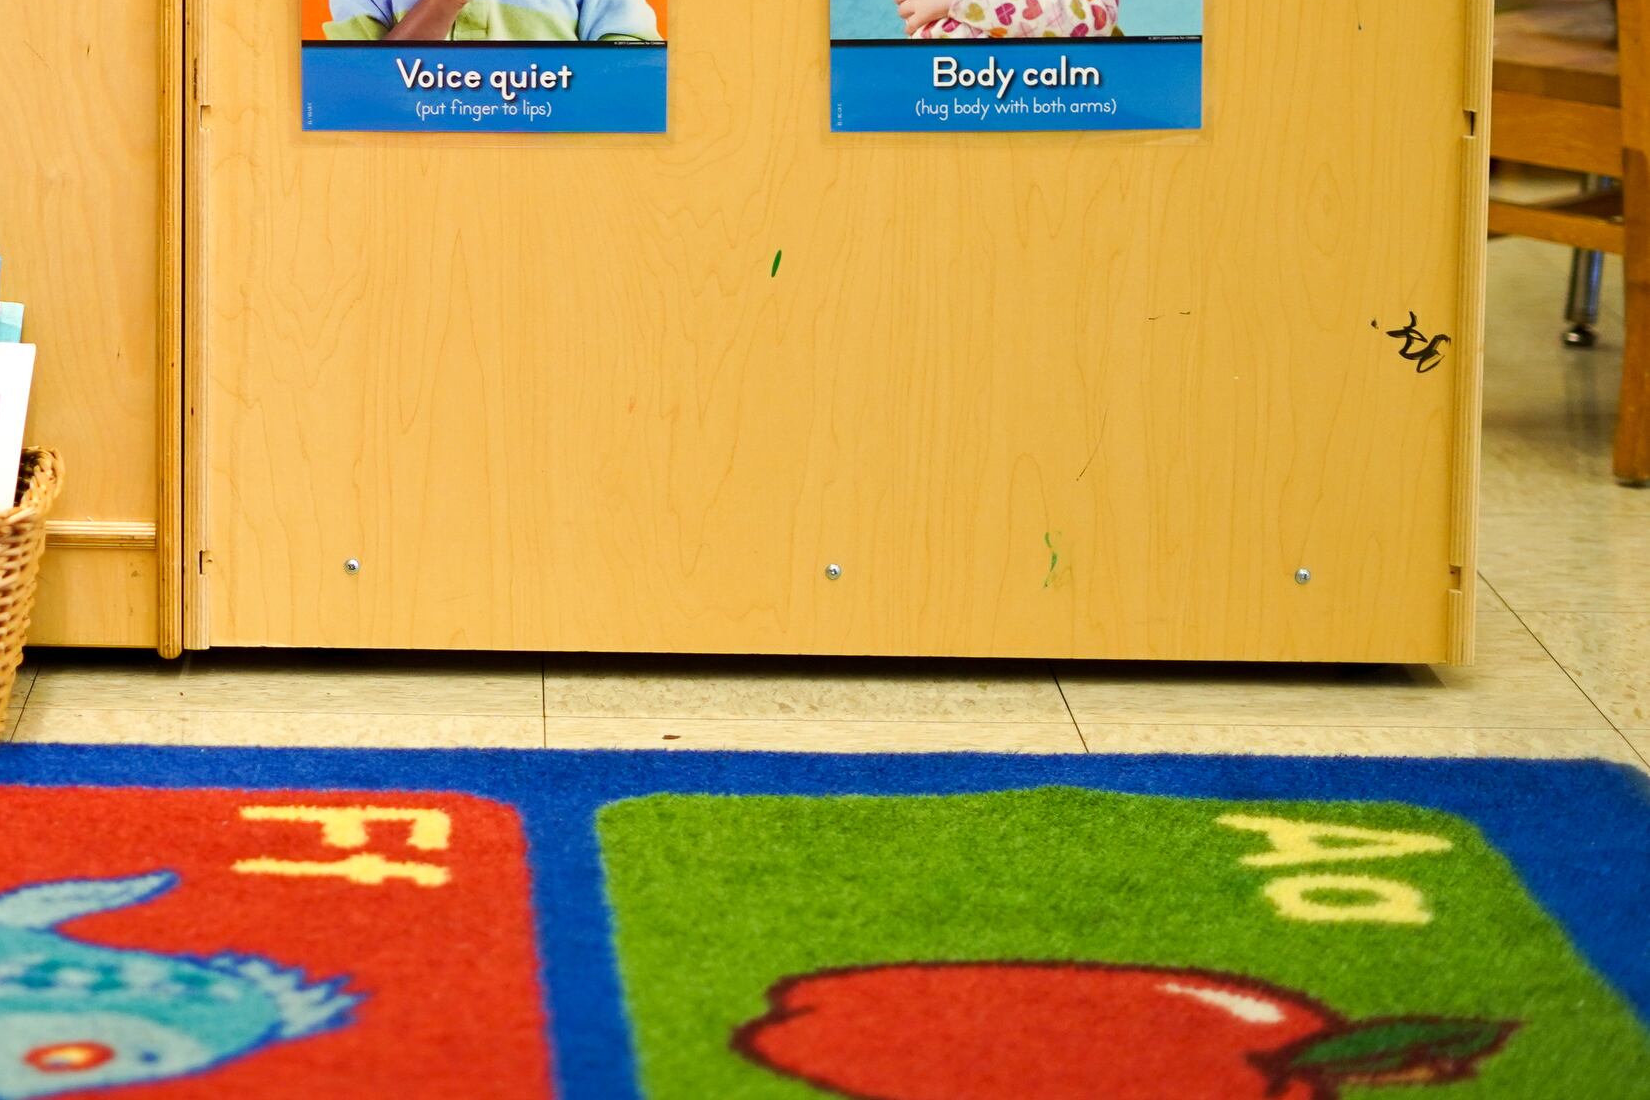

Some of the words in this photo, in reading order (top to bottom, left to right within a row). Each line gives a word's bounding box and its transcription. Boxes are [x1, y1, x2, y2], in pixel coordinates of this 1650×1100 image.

[396, 57, 483, 89] Voice
[489, 62, 573, 102] quiet
[933, 56, 1016, 99] Body
[1023, 55, 1101, 87] calm
[415, 101, 447, 119] (put
[450, 99, 500, 122] finger
[502, 101, 518, 117] to
[522, 100, 553, 119] lips)
[915, 99, 950, 121] (hug
[954, 98, 990, 120] body
[995, 97, 1030, 115] with
[1033, 97, 1067, 115] both
[1070, 98, 1118, 116] arms)
